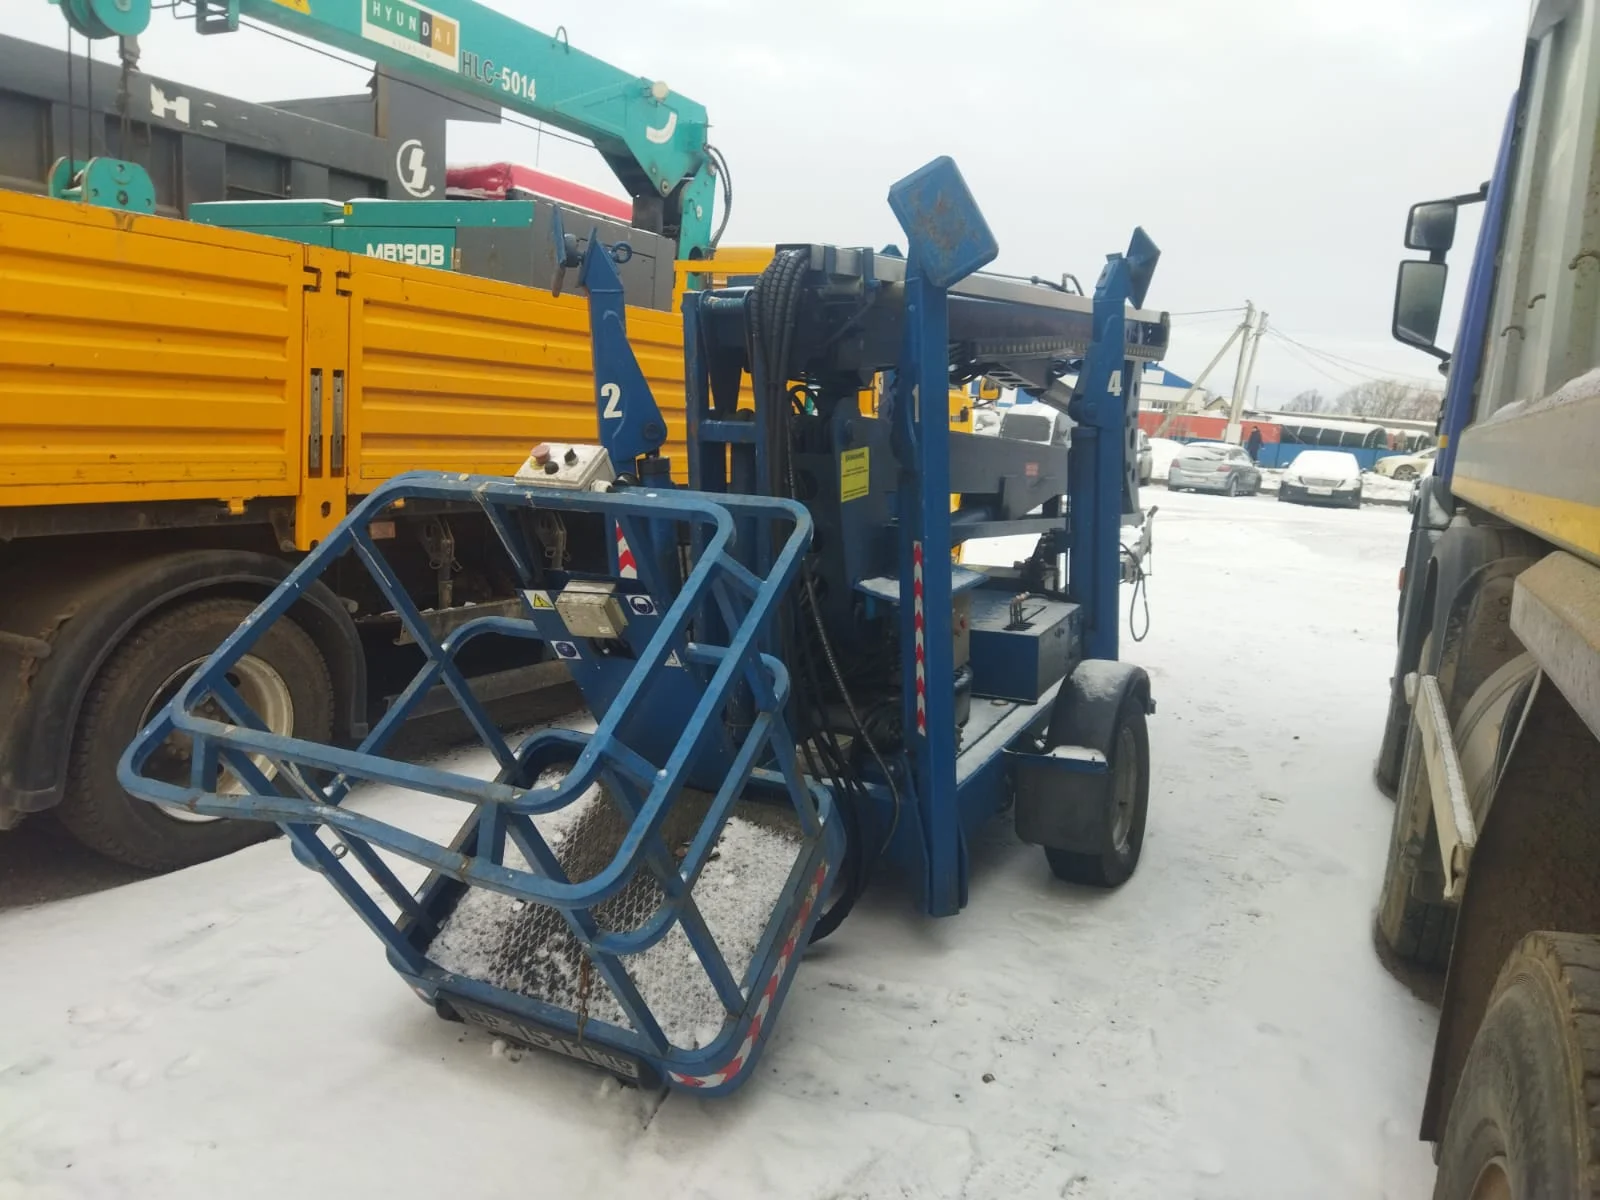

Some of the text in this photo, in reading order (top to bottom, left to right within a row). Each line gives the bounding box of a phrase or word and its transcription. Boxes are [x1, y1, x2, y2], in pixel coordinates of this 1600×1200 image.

[373, 1, 451, 46] HYUNDAI
[461, 50, 537, 101] HLC-5014
[600, 383, 623, 419] 2
[1107, 369, 1122, 397] 4
